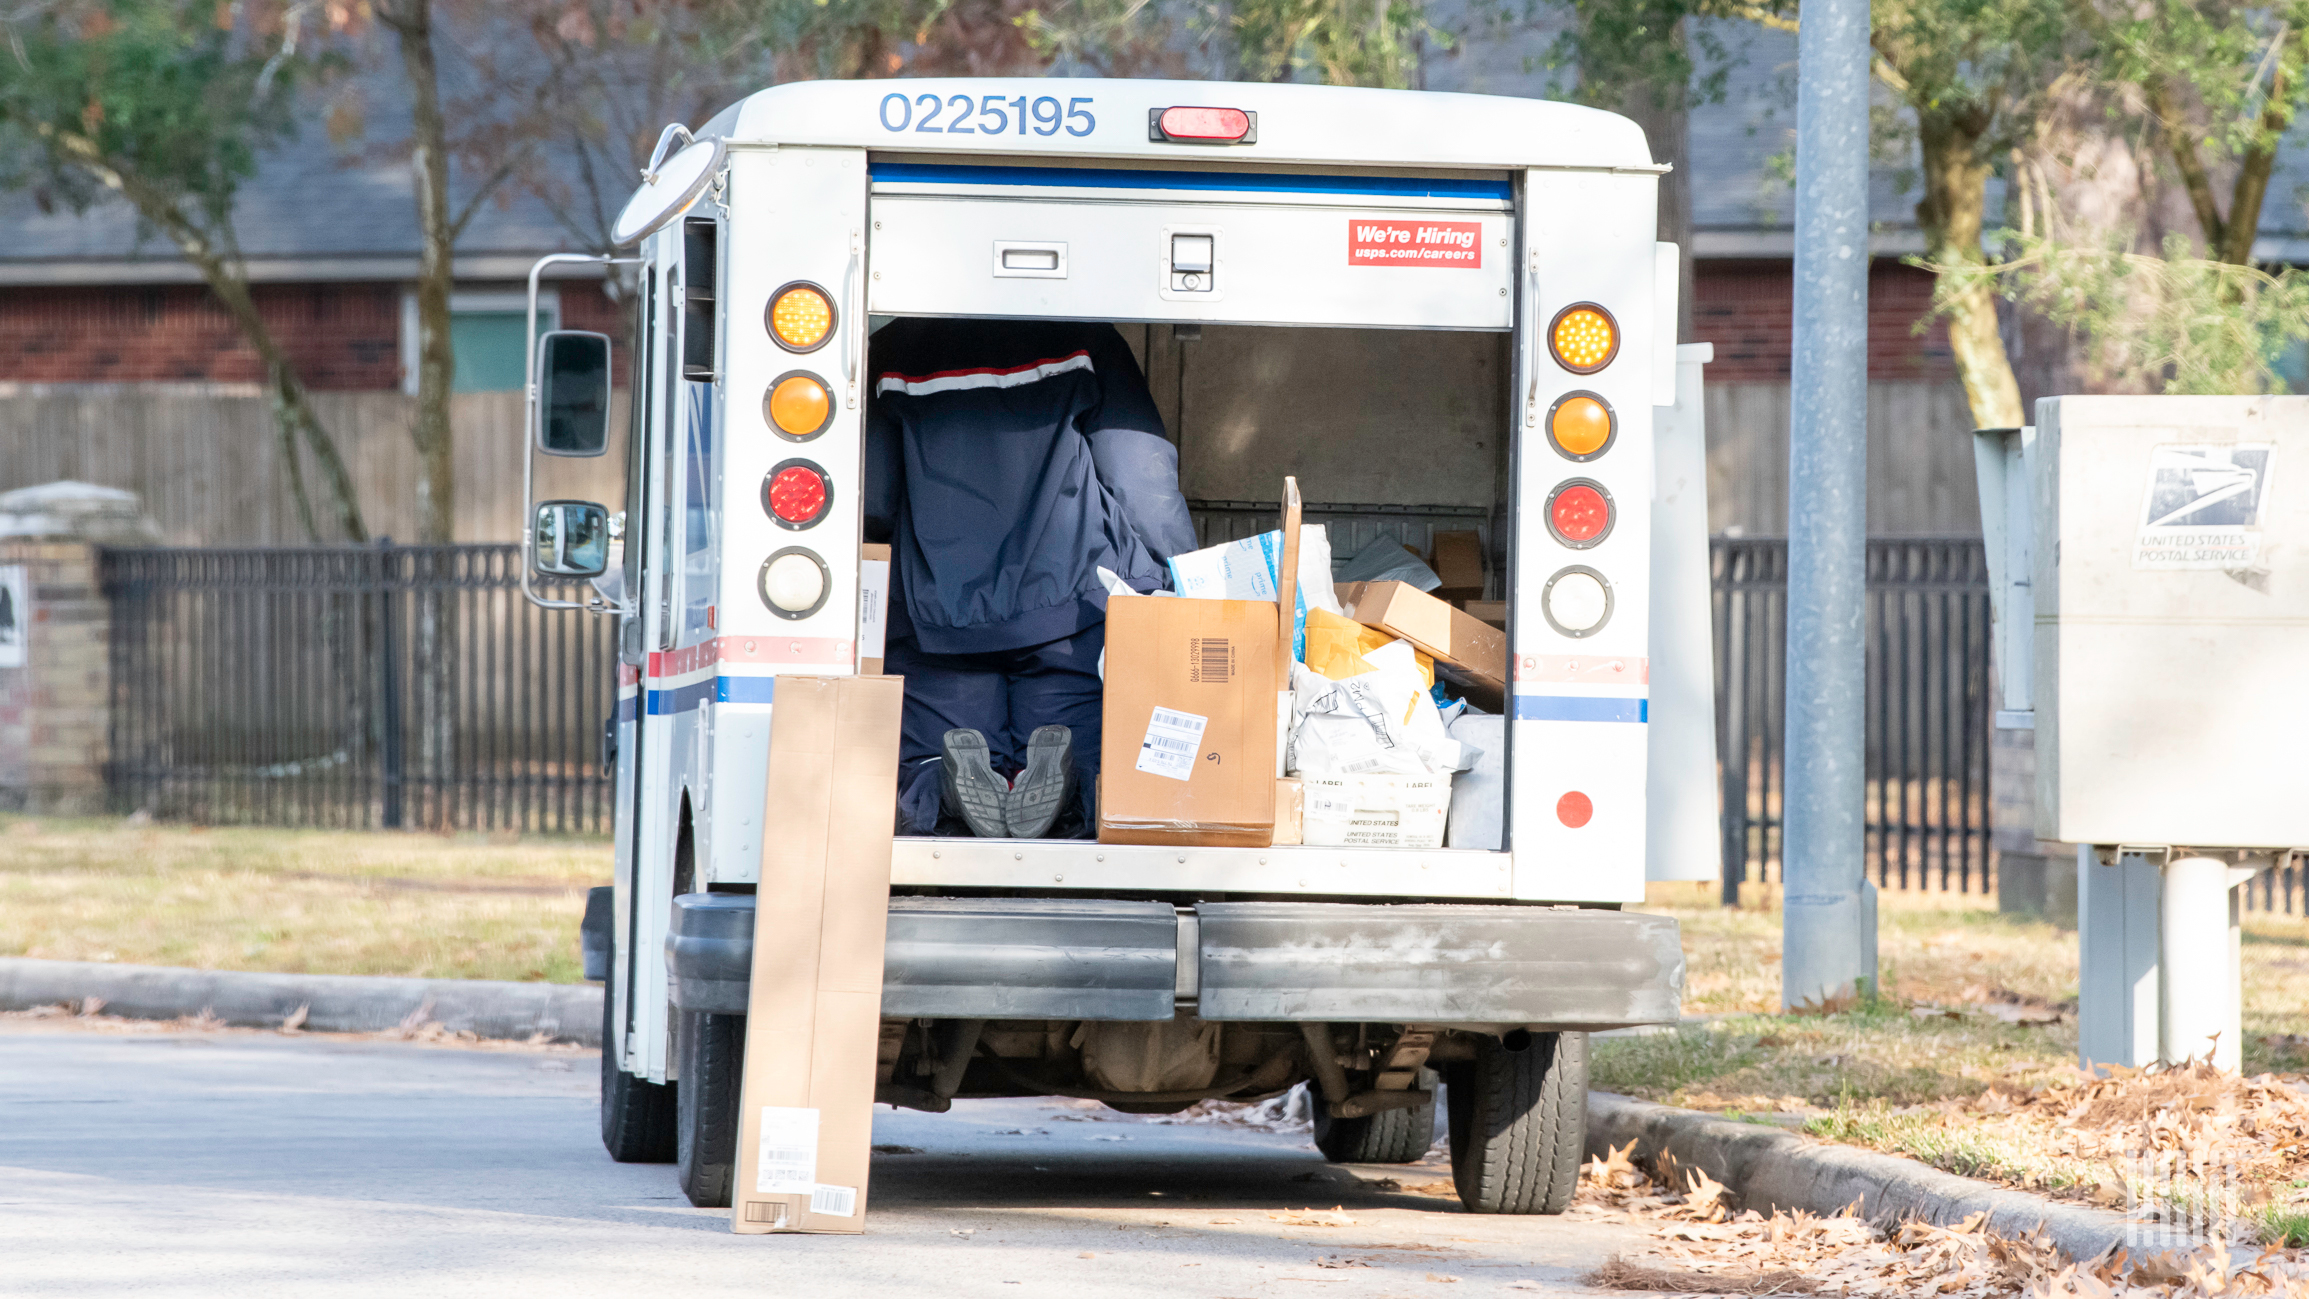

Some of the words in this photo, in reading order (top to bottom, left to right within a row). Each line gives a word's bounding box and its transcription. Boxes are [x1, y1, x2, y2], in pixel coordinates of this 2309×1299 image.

[879, 92, 1096, 138] 0225195
[1356, 225, 1411, 243] We're
[1415, 226, 1475, 248] Hiring
[1355, 247, 1475, 260] usps.com/careers
[2141, 534, 2195, 546] UNITED
[2196, 534, 2246, 546] STATES
[1222, 555, 1233, 579] prime
[2139, 549, 2190, 562] POSTAL
[2193, 549, 2250, 562] SERVICE
[1254, 571, 1268, 595] prime
